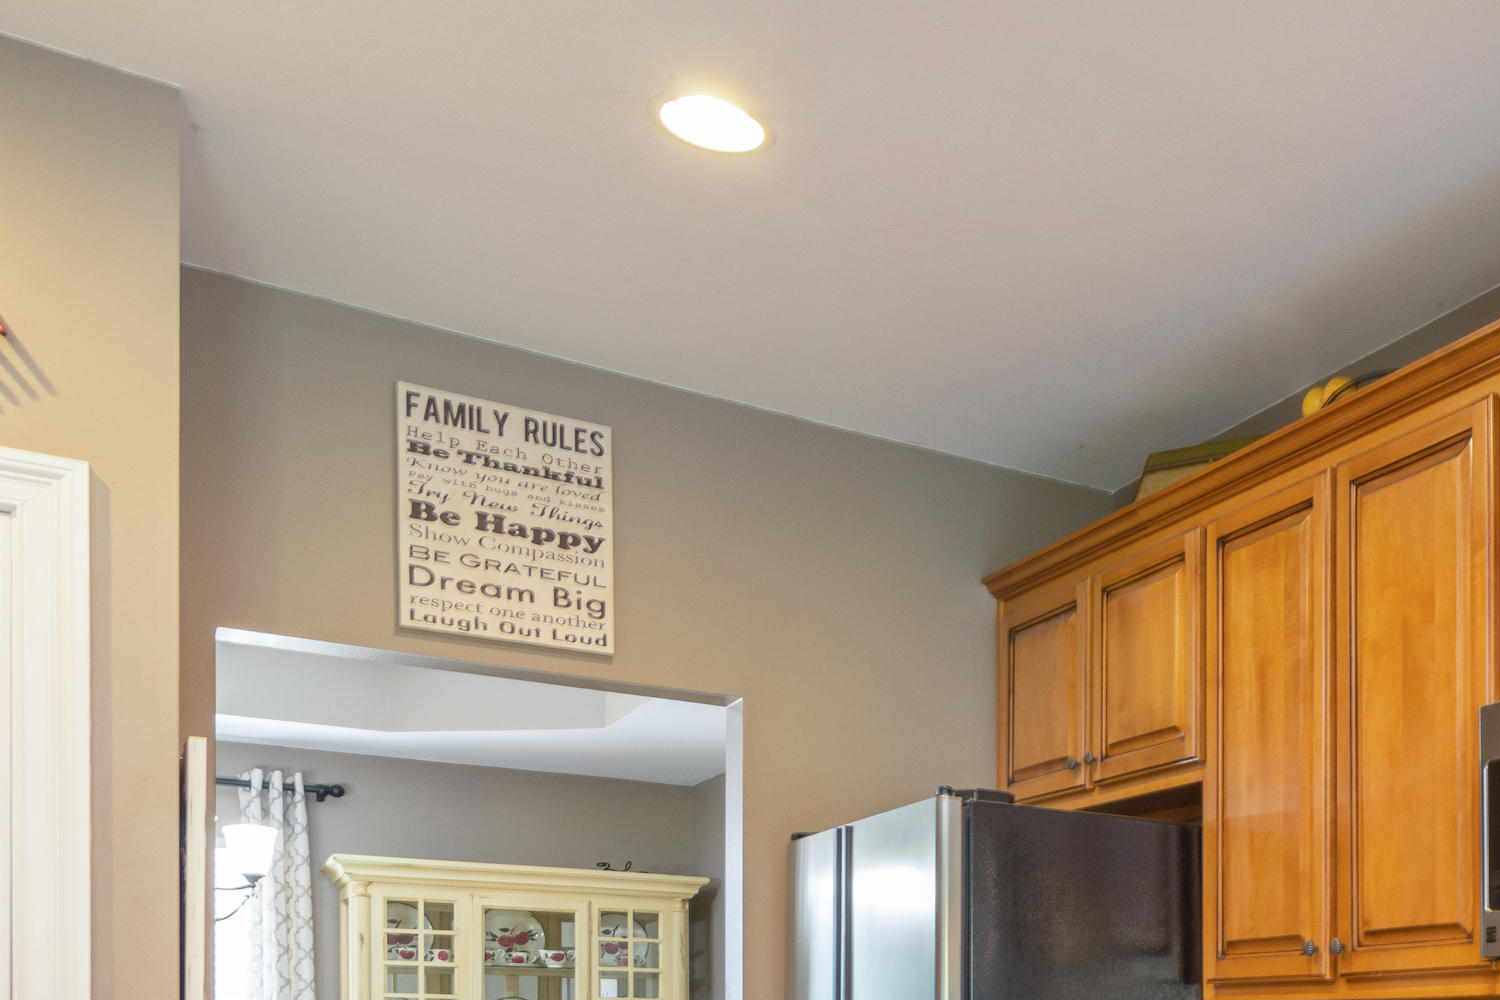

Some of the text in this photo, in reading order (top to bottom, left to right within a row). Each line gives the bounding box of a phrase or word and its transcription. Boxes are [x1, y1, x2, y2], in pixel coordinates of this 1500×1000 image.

[406, 390, 605, 457] FAMILY RULES
[406, 439, 606, 490] Be Thankful
[407, 425, 605, 475] Help Each Other
[406, 456, 608, 502] Know you are loved
[408, 478, 605, 531] Try New Things
[408, 498, 606, 554] Be Happy
[409, 522, 606, 569] Show Compassion
[409, 543, 607, 589] BE GRATEFUL
[408, 563, 606, 620] Dream Big
[410, 594, 607, 631] respect one another
[410, 607, 608, 648] Laugh Out Loud
